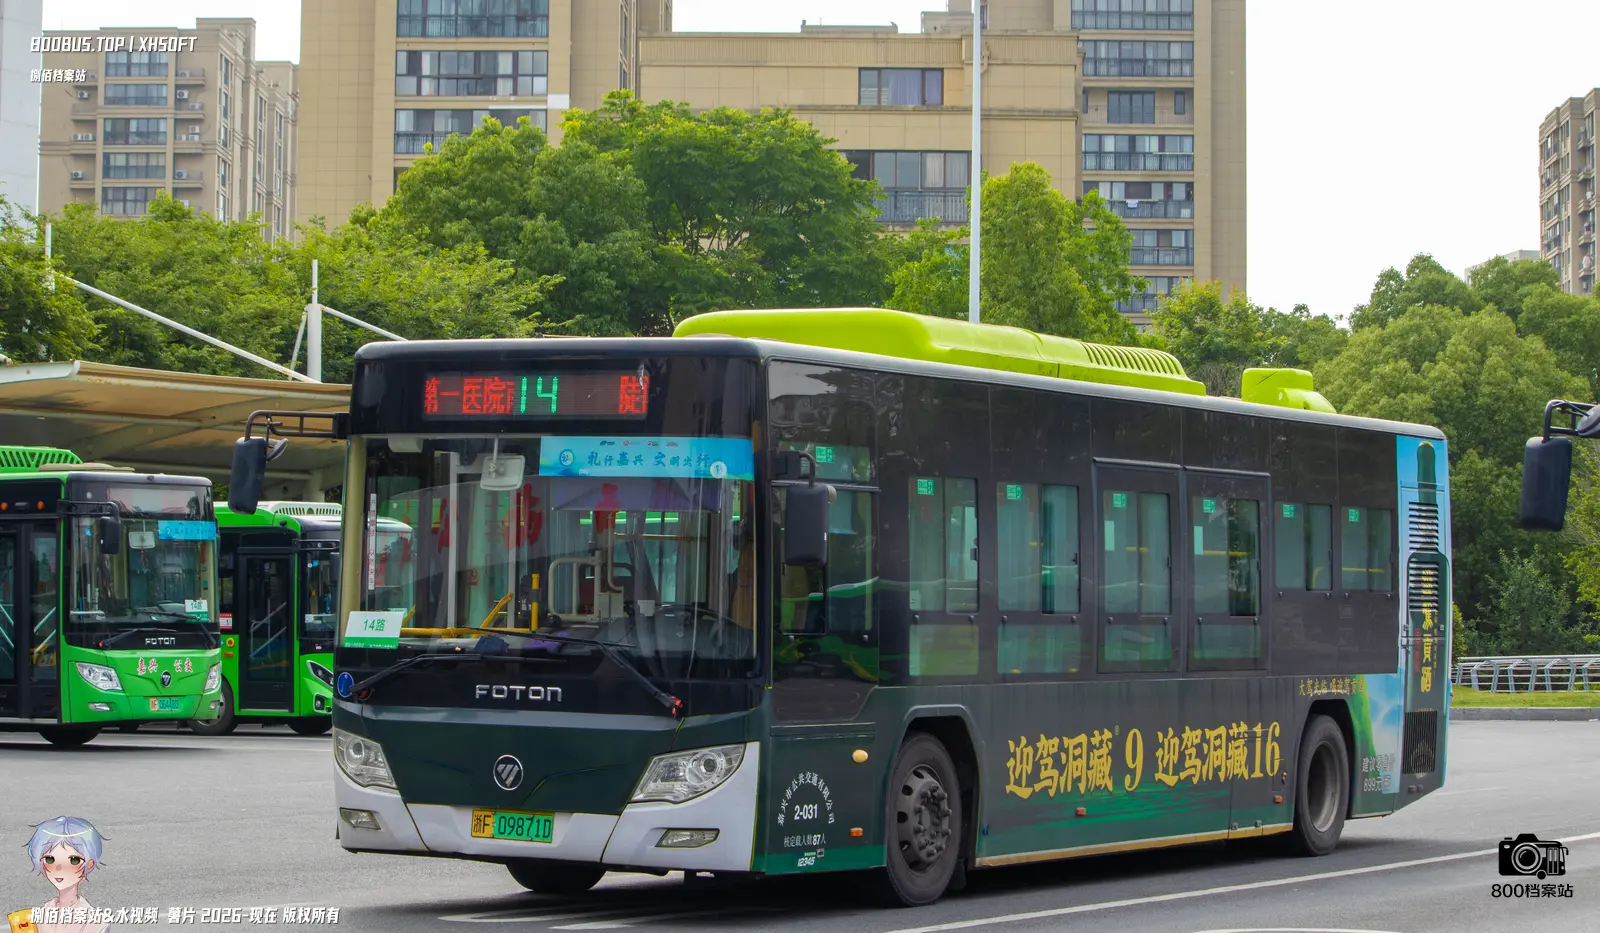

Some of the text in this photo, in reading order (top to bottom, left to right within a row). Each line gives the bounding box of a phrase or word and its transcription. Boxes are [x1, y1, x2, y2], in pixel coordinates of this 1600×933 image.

[519, 376, 559, 415] 14
[587, 450, 711, 468] 礼行嘉兴 文明出行
[363, 618, 386, 632] 14路
[145, 637, 176, 646] FOTON
[137, 656, 194, 676] 嘉兴 公交
[475, 684, 563, 703] FOTON
[1005, 727, 1114, 800] 迎驾洞藏
[1124, 727, 1145, 793] 9
[793, 803, 819, 820] 2-031
[797, 856, 816, 867] 12345
